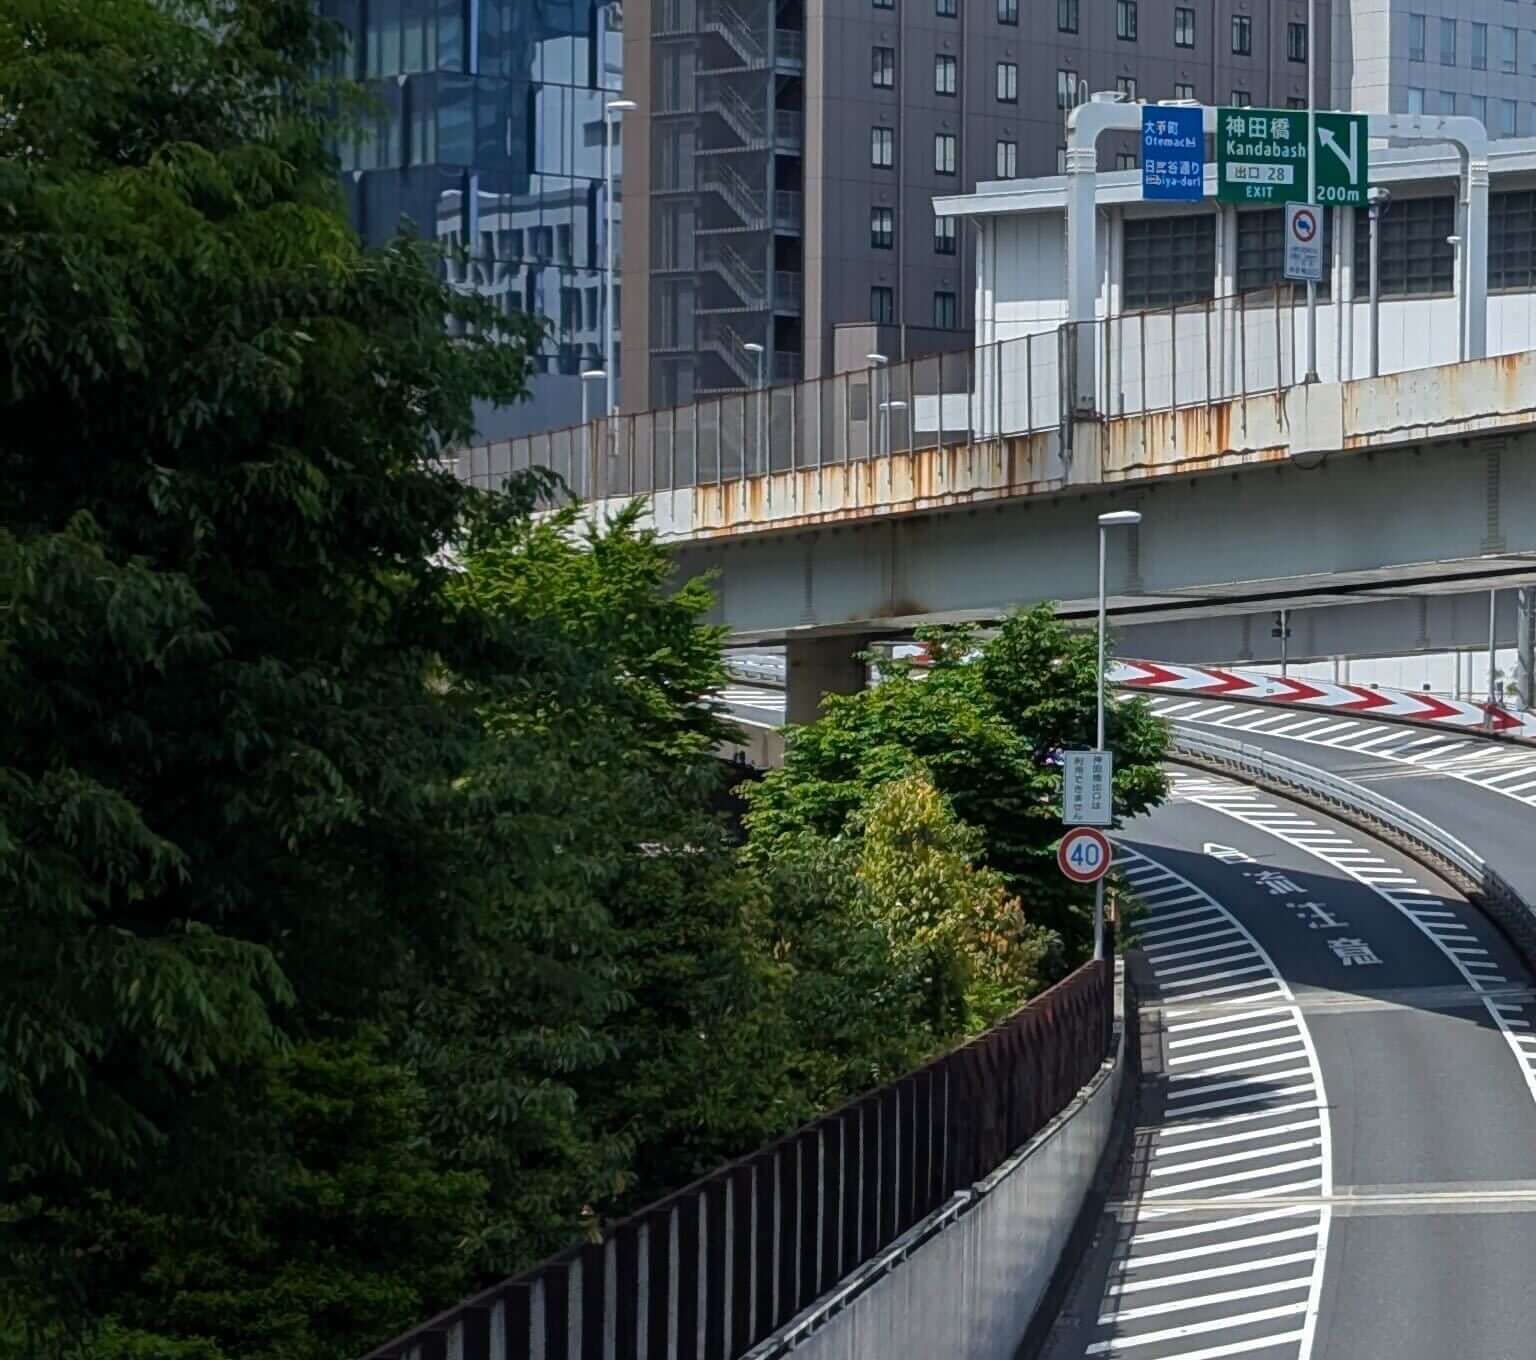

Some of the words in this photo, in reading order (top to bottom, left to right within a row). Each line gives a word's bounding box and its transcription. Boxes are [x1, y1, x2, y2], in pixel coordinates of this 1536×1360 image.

[1225, 115, 1290, 140] 神田橋
[1226, 140, 1306, 158] Kandabash
[1235, 167, 1260, 179] 出口
[1267, 167, 1285, 181] 28
[1246, 186, 1273, 198] EXIT
[1316, 185, 1360, 201] 200m
[1071, 843, 1099, 866] 40
